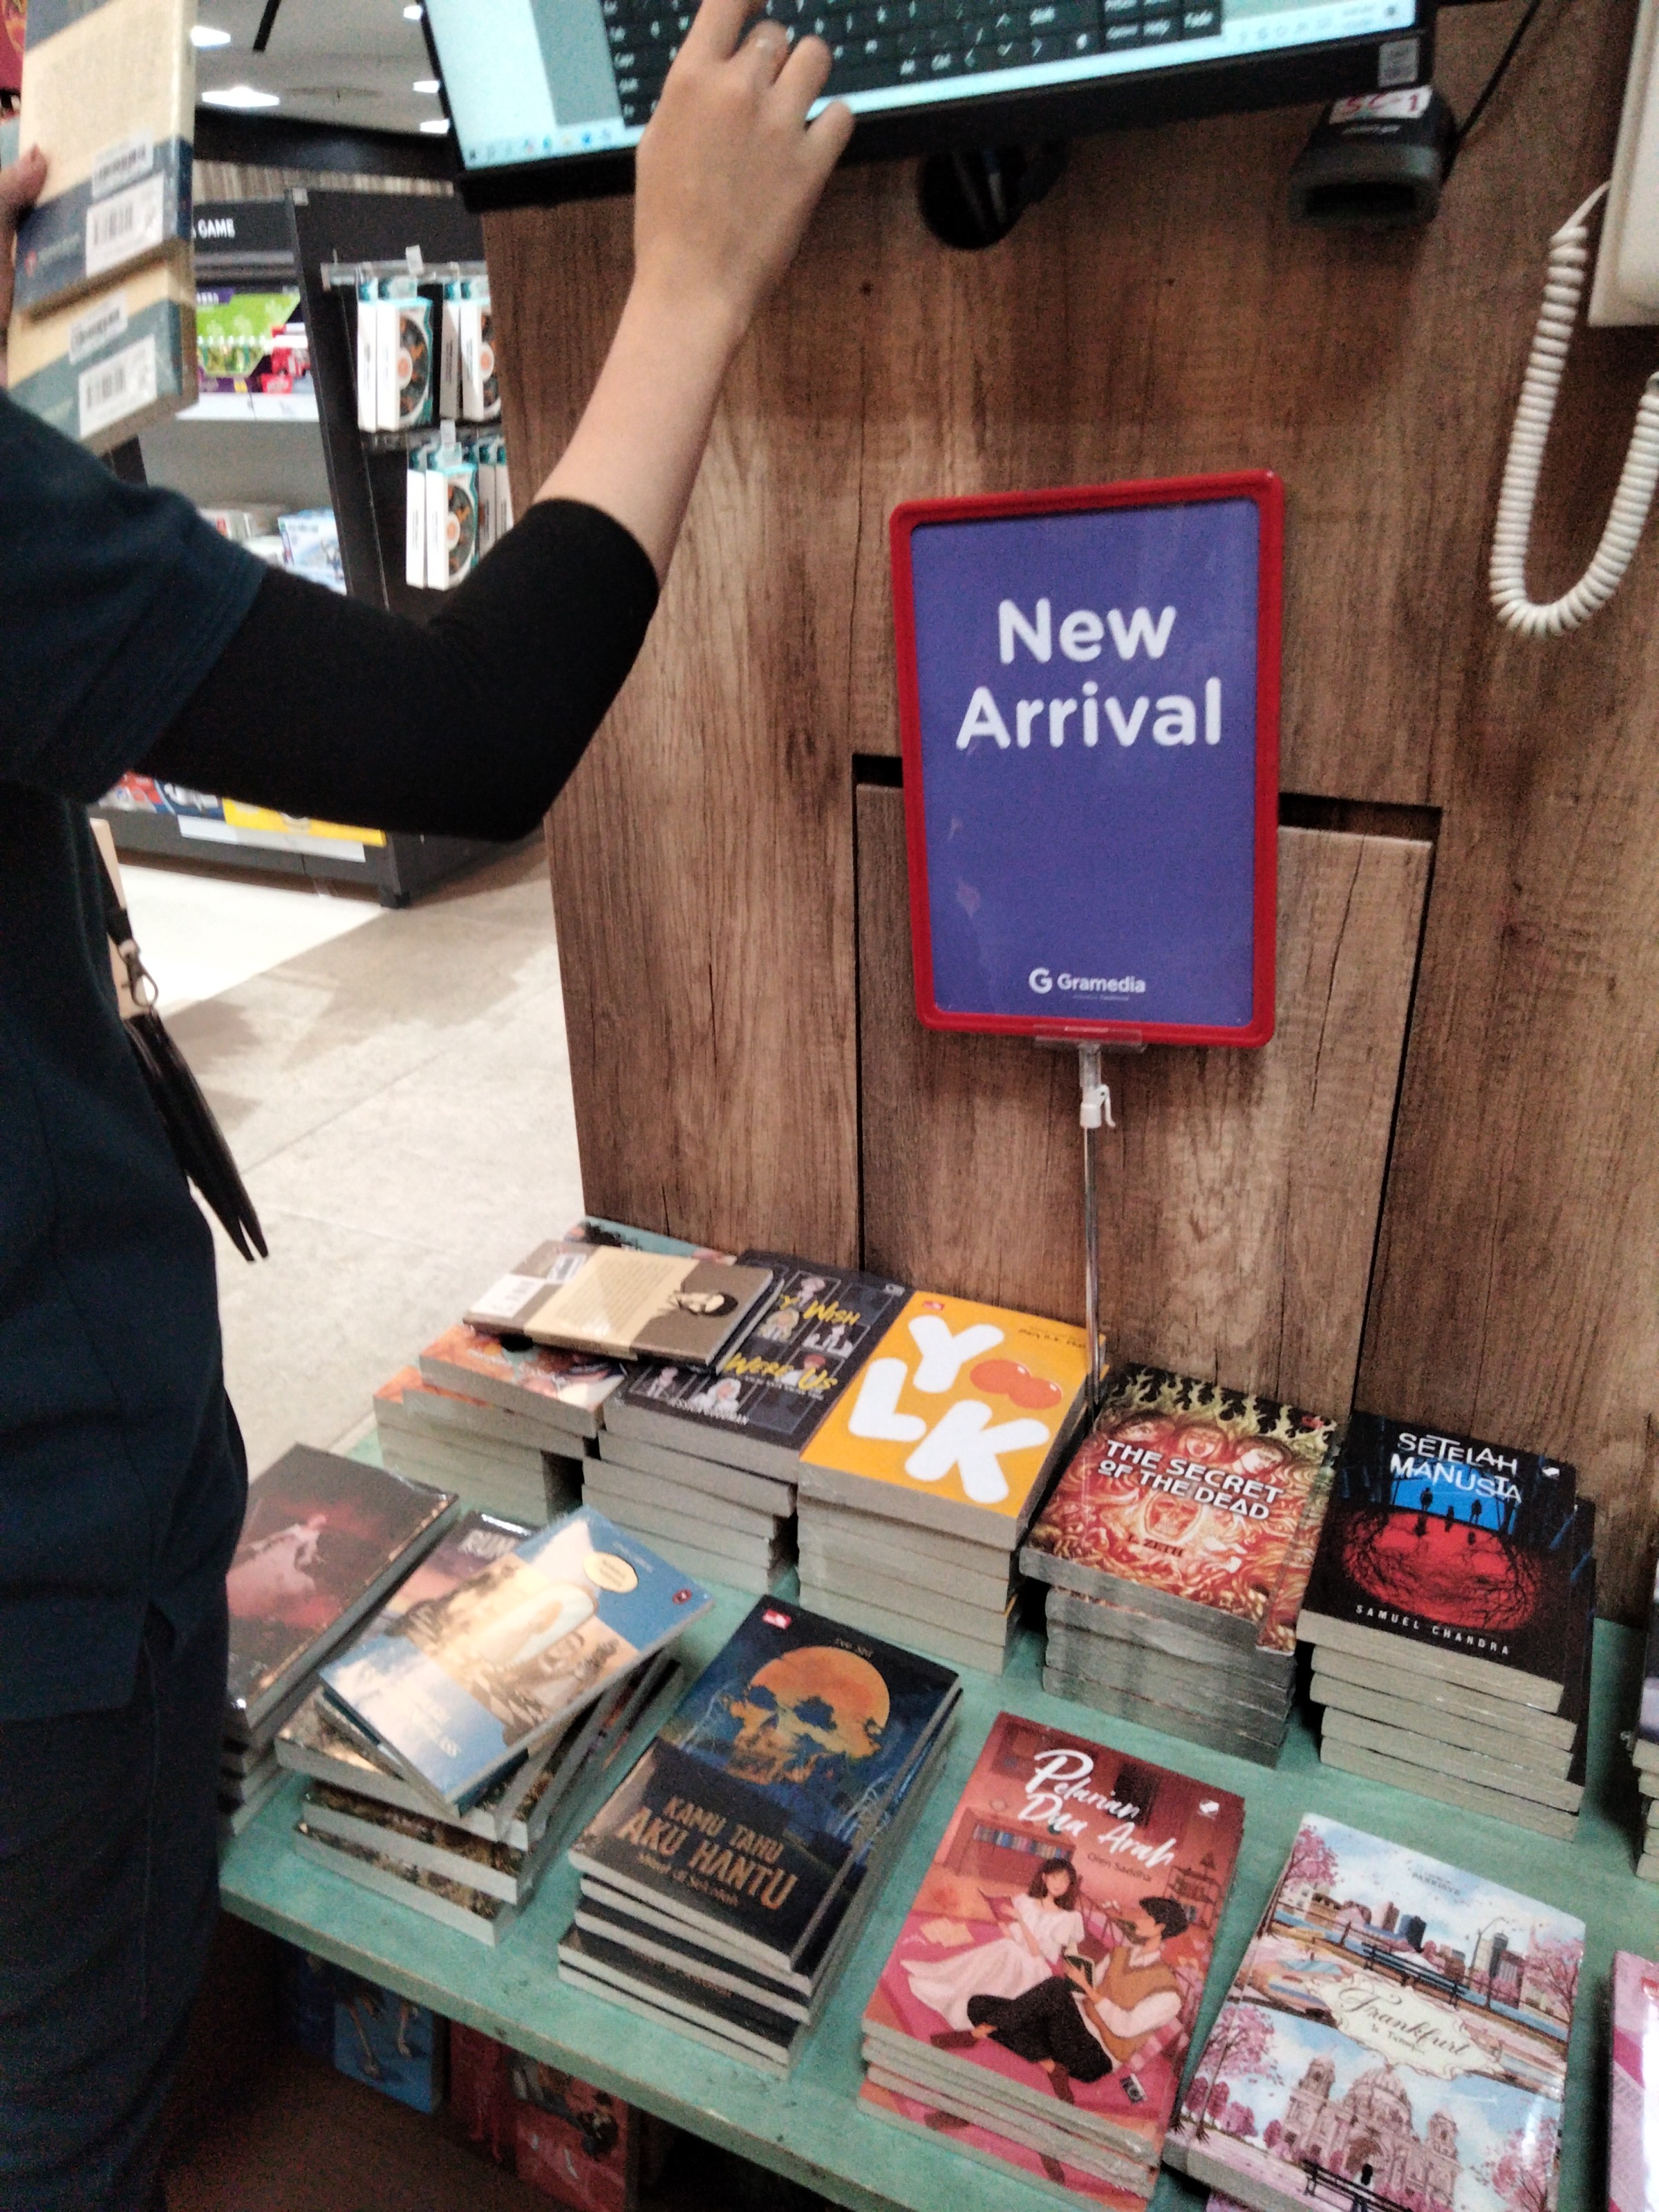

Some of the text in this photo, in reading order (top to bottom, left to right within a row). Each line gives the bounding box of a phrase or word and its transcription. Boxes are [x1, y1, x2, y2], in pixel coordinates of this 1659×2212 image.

[198, 218, 236, 238] GAME
[998, 598, 1177, 664] New
[956, 677, 1221, 750] Arrival
[1057, 973, 1146, 993] Gramedia
[1107, 1439, 1284, 1503] THE SECRET
[1390, 1453, 1521, 1503] MANUSIA
[1398, 1432, 1517, 1477] SETELAH
[1098, 1460, 1269, 1520] OF THE DEAD
[1356, 1604, 1509, 1655] SAMUEL CHANDRA
[1025, 1749, 1140, 1818] Pelarian
[663, 1795, 726, 1837] KAMU
[615, 1806, 690, 1857] AKU
[688, 1839, 798, 1910] HANTU
[1098, 1821, 1177, 1868] Arah
[1340, 1987, 1470, 2055] Frankfurt
